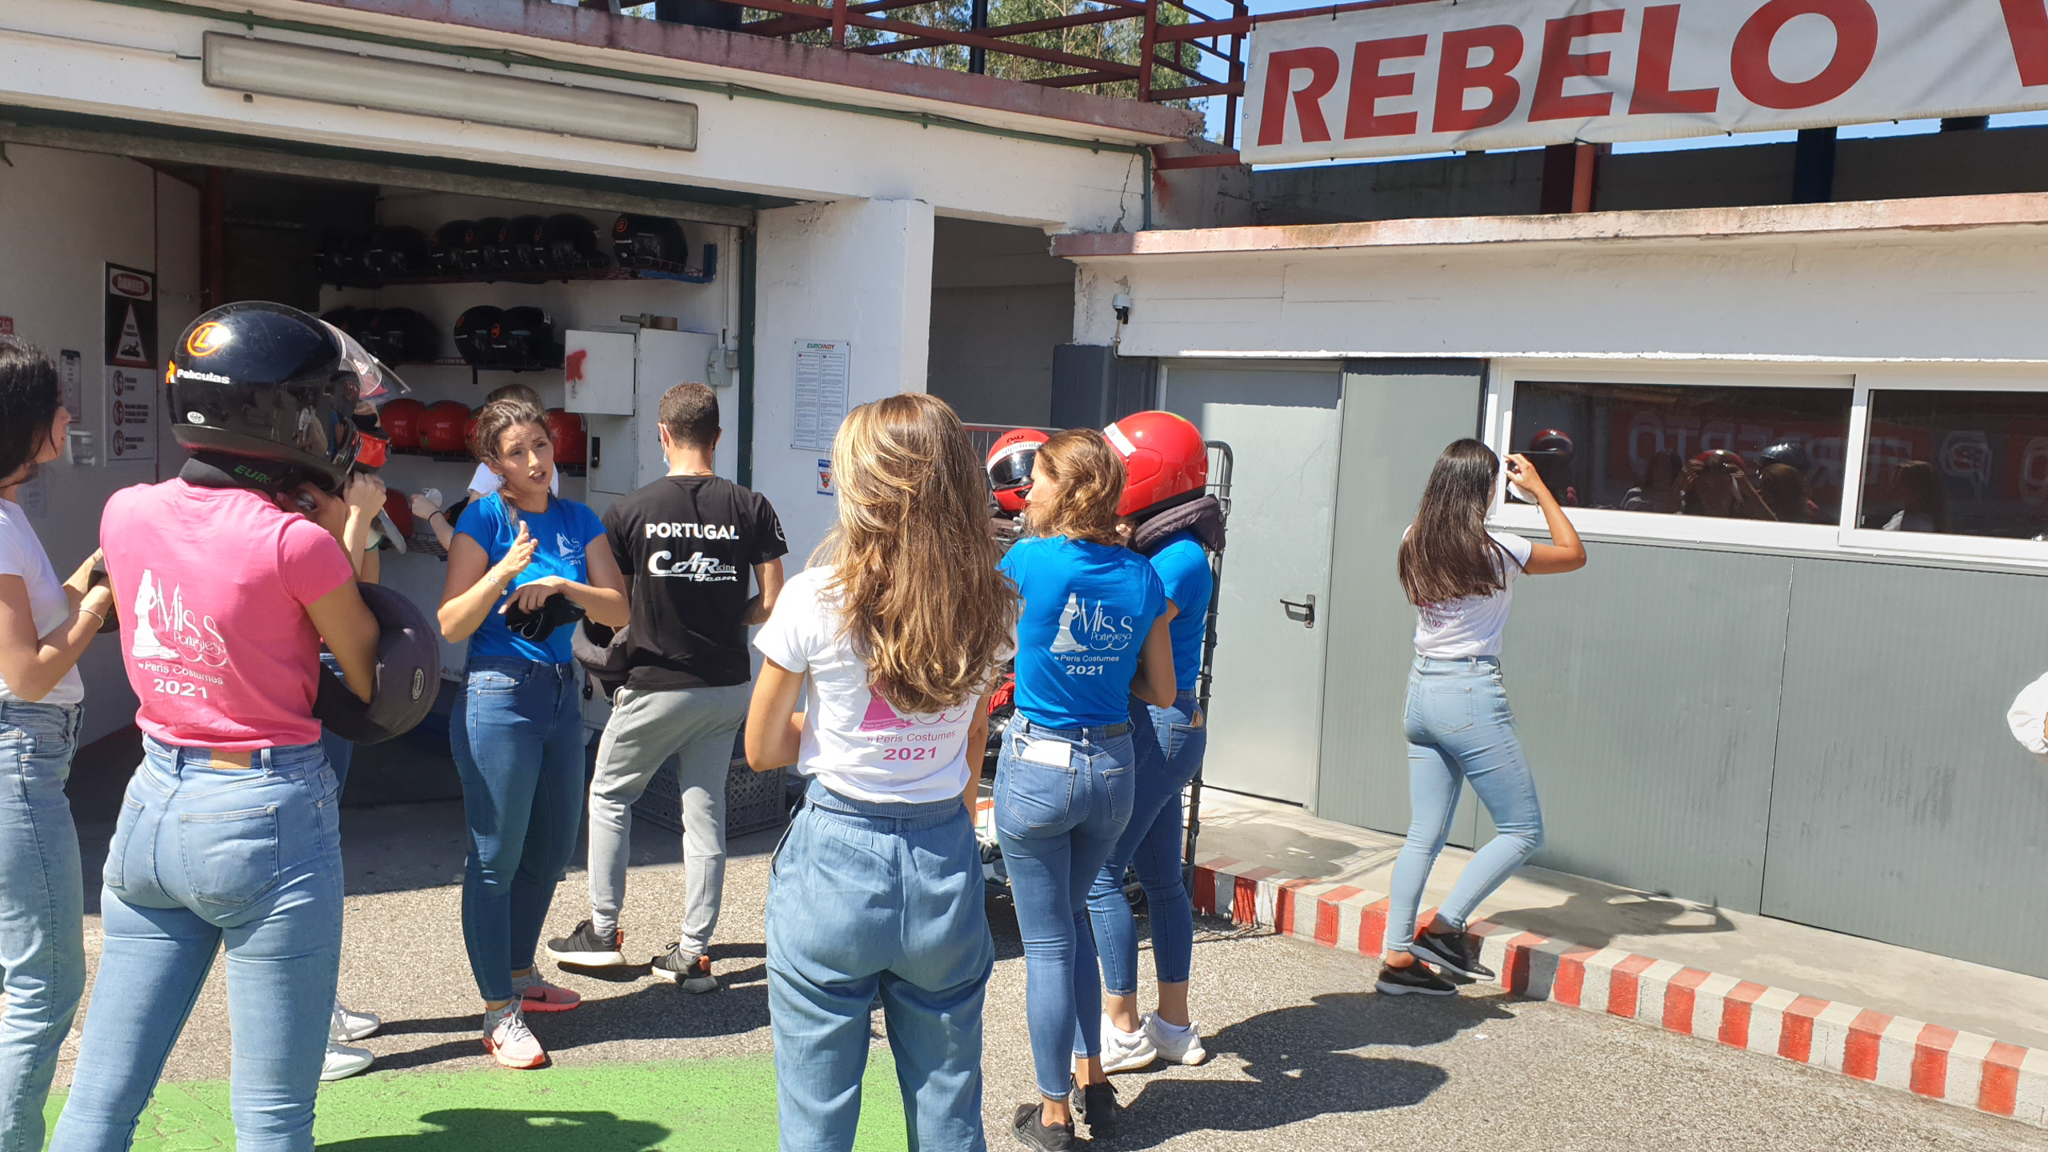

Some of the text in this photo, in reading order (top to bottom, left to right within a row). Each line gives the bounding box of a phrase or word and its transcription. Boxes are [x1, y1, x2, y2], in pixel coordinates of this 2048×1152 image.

[1257, 0, 1878, 147] REBELO
[807, 342, 835, 350] EUROINDY
[645, 522, 739, 540] PORTUGAL
[1078, 597, 1133, 634] Miss
[1060, 654, 1081, 662] Peris
[1082, 654, 1120, 662] Costumes
[145, 660, 170, 674] Peris
[172, 664, 225, 685] Costumes
[1065, 665, 1104, 675] 2021
[153, 678, 208, 699] 2021
[876, 734, 904, 744] Peris
[906, 730, 956, 742] Costumes
[883, 746, 937, 761] 2021
